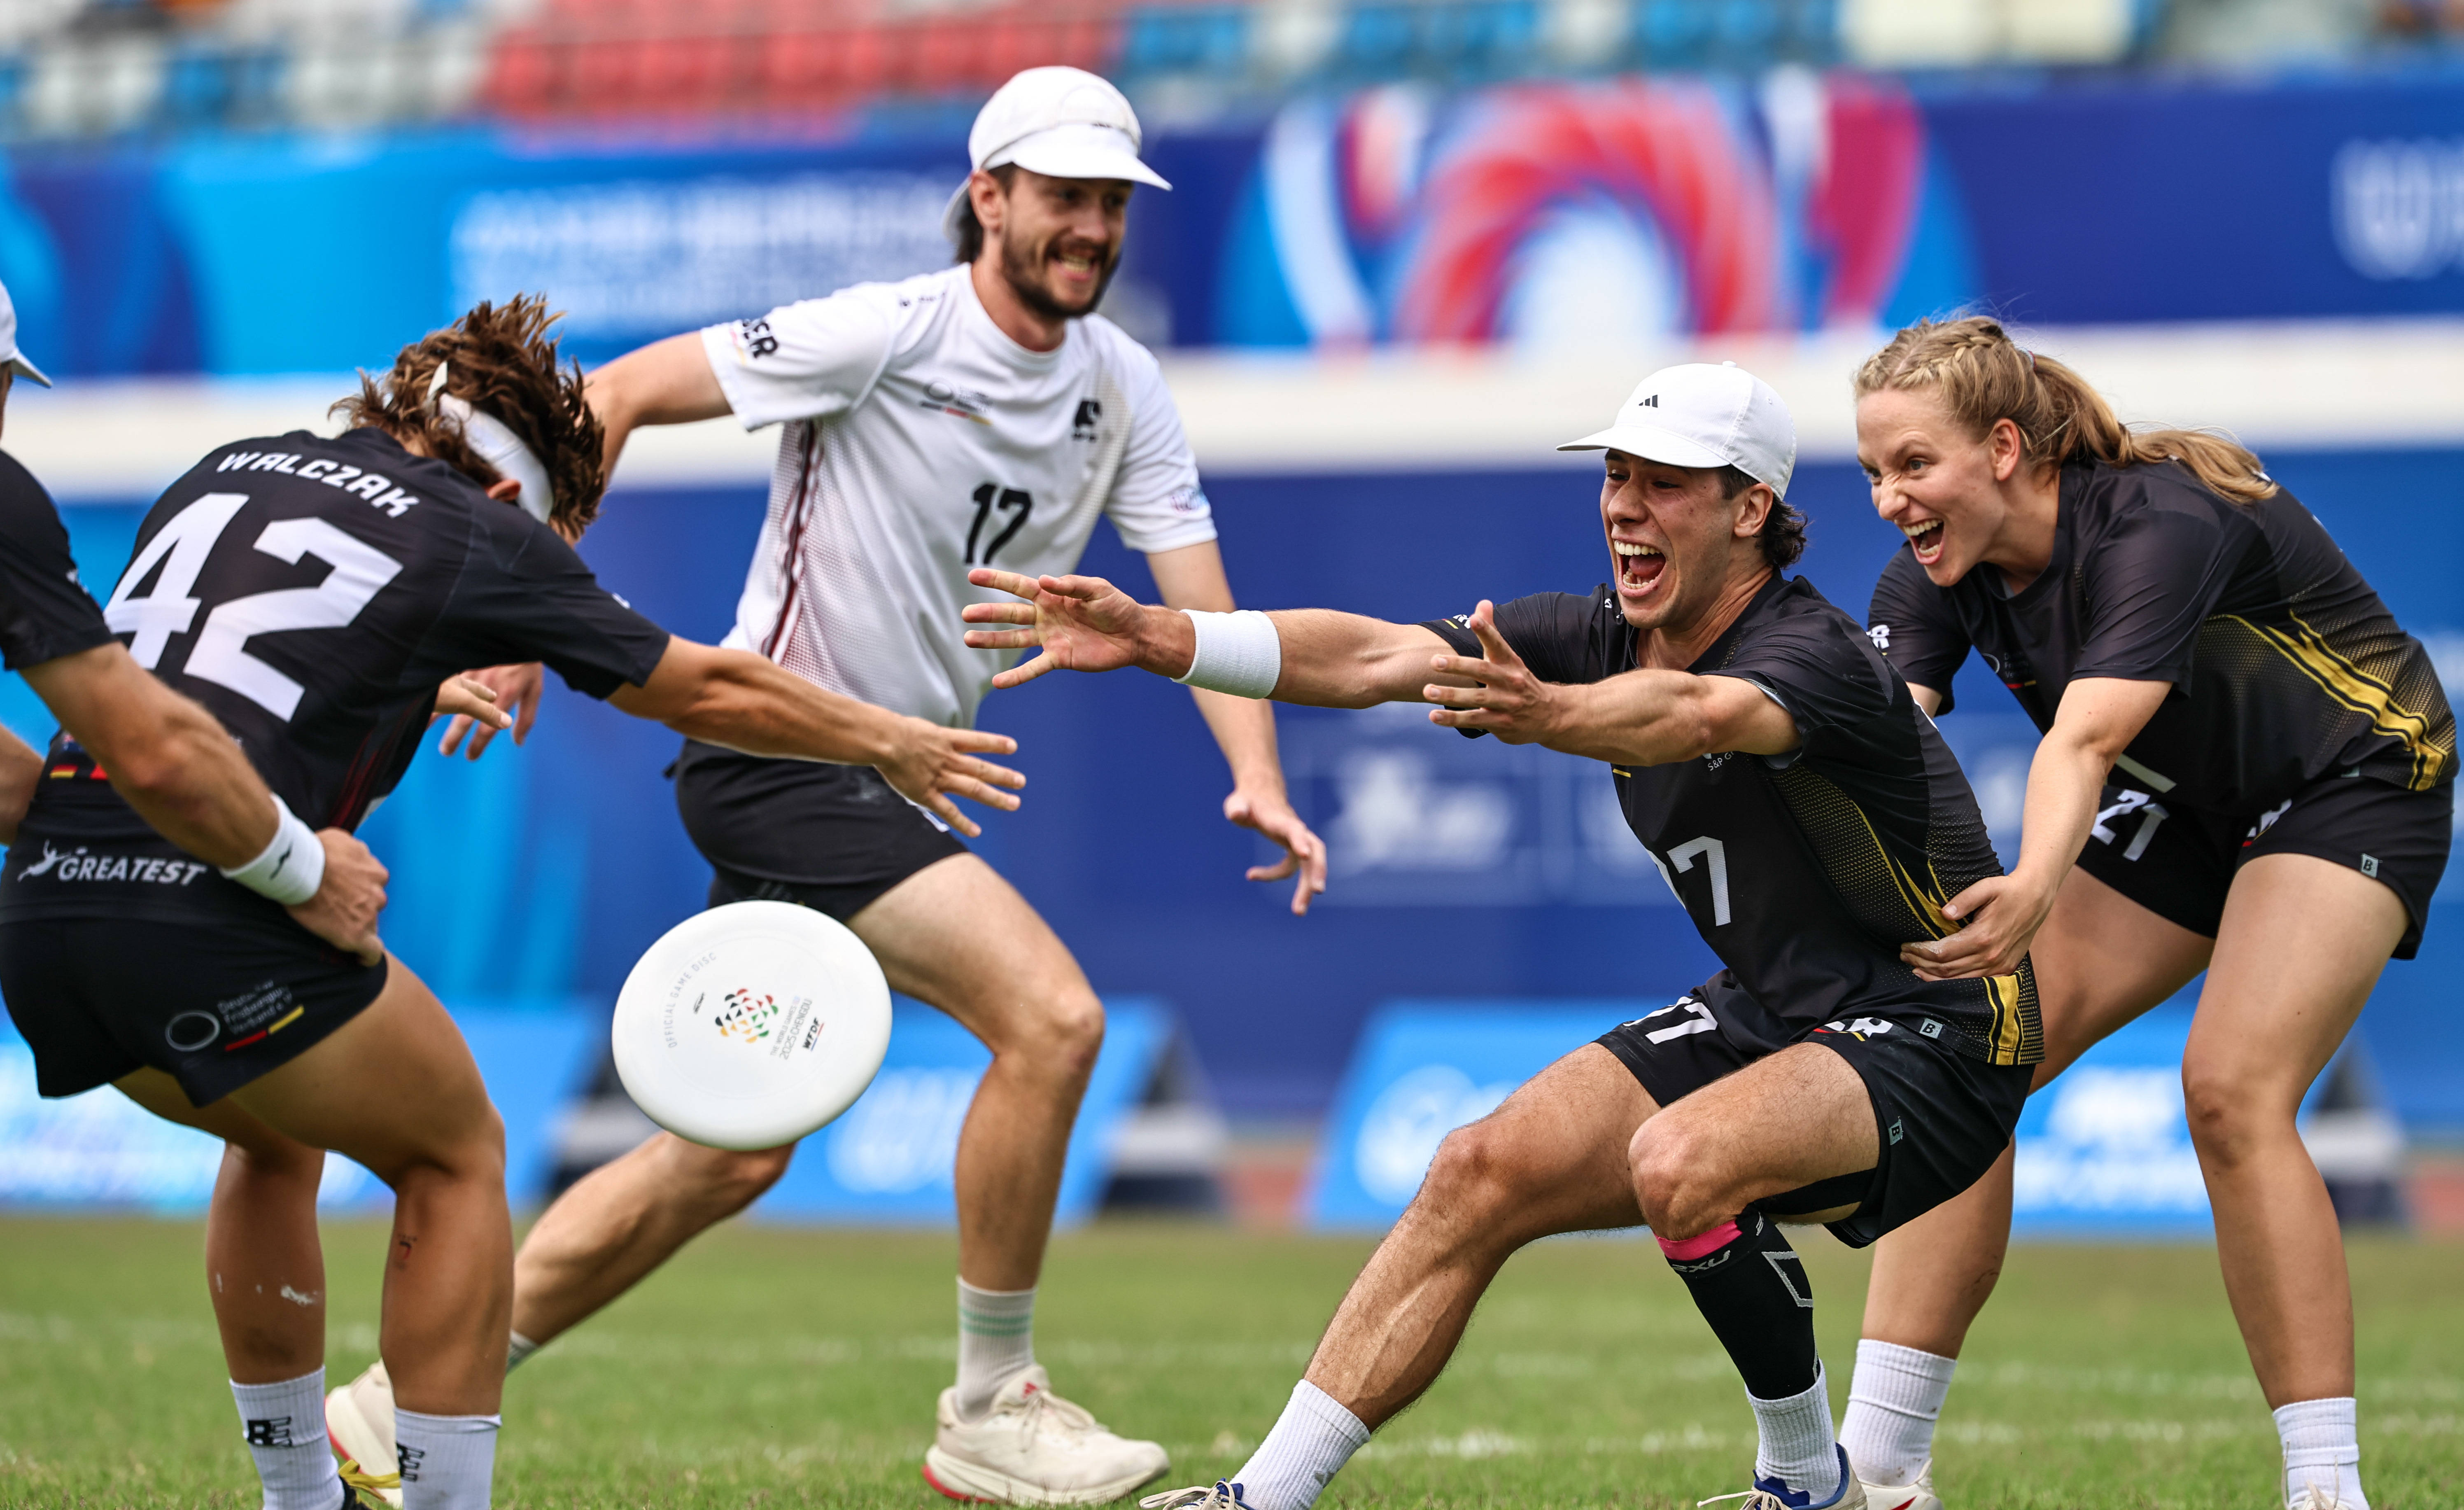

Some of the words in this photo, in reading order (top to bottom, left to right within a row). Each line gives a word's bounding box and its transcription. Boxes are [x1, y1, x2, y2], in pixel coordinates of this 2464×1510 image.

[217, 451, 419, 518] WALCZAK
[965, 483, 1033, 564] 17
[103, 492, 403, 722] 42
[1707, 758, 1723, 771] S&P
[2091, 789, 2169, 861] 21
[58, 856, 207, 885] GREATEST
[1647, 836, 1731, 927] 7
[670, 972, 692, 998] GAME
[692, 952, 716, 971] DISC
[664, 1002, 678, 1048] OFFICIAL
[770, 1046, 780, 1056] THE
[776, 1025, 788, 1044] WORLD
[784, 1005, 797, 1025] GAMES
[779, 1035, 797, 1060] 2025
[790, 998, 813, 1035] CHENGDU
[802, 1017, 820, 1049] WFDF
[1672, 1250, 1730, 1273] 2XU
